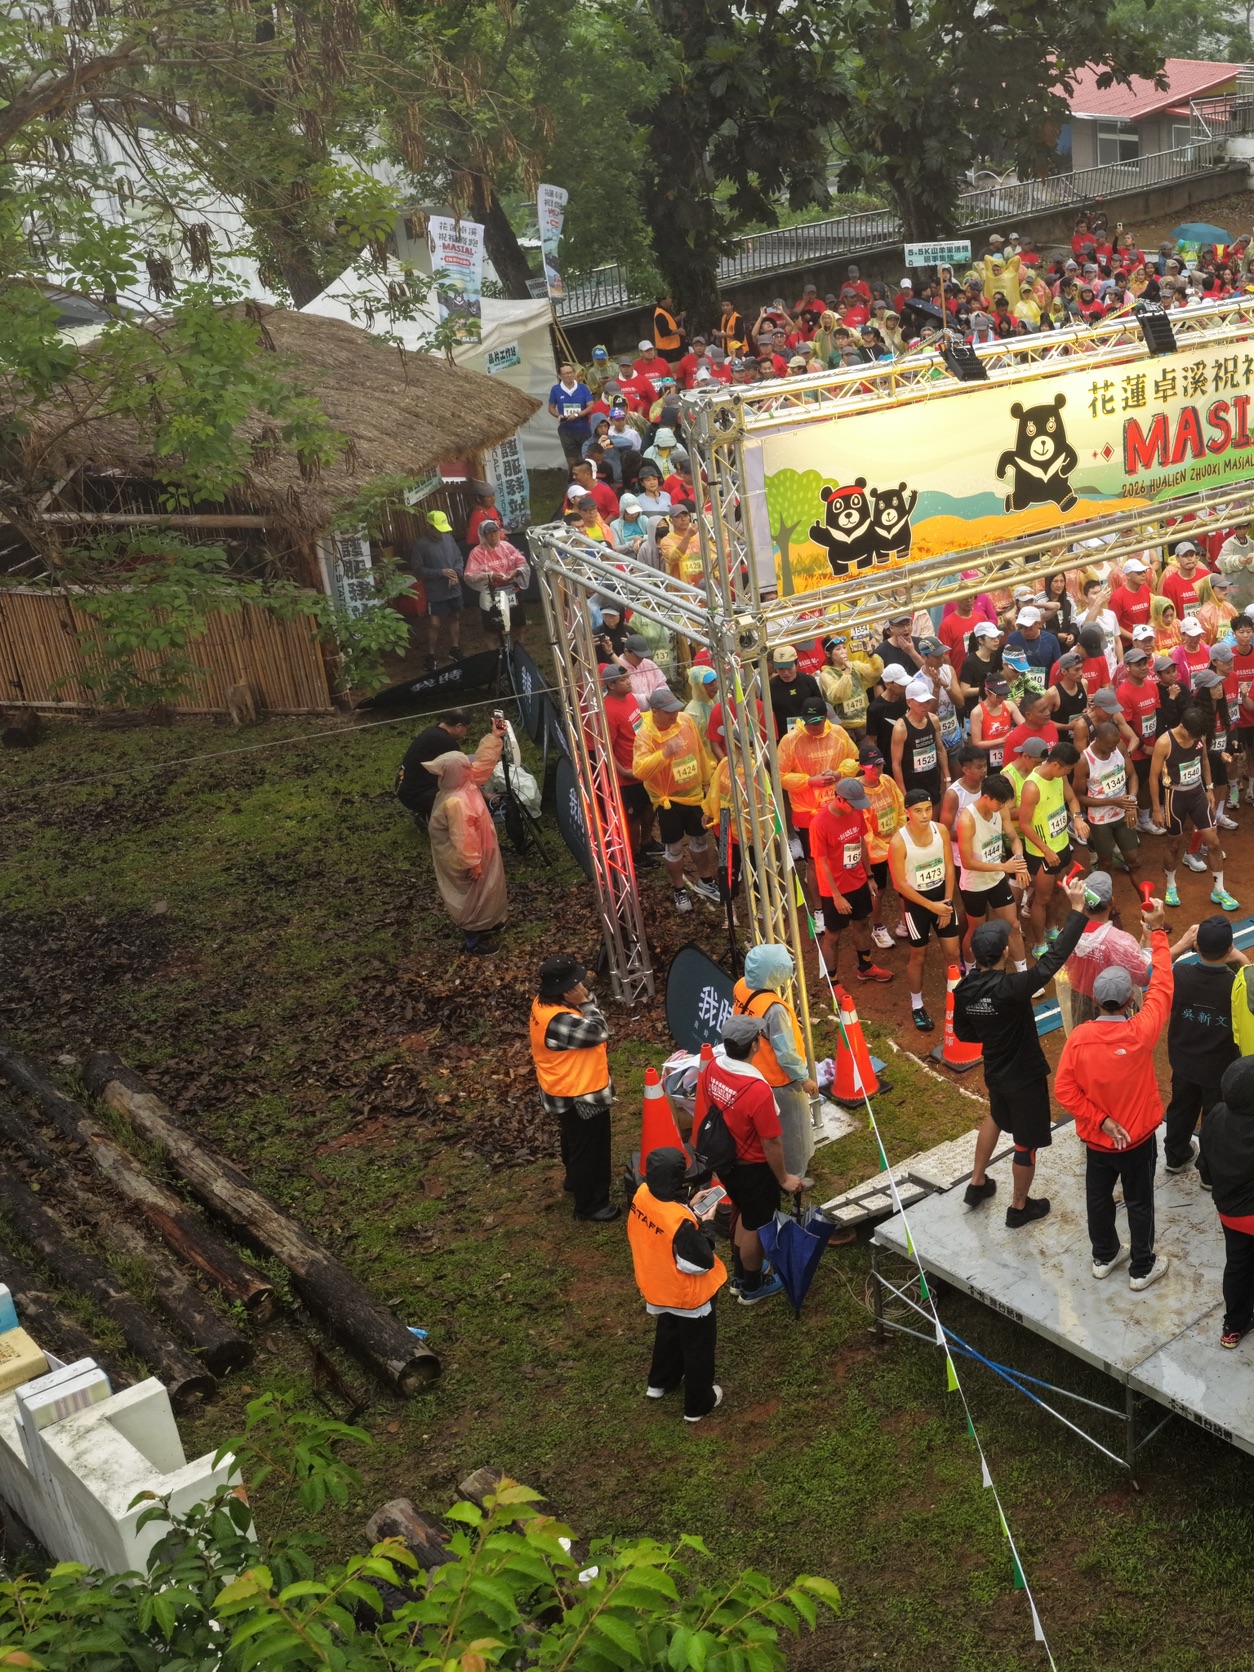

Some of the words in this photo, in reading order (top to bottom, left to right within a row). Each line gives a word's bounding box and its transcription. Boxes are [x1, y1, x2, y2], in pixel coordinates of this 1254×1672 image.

[442, 242, 474, 255] MASIAL
[1121, 483, 1146, 499] 2026
[1149, 473, 1187, 493] HUALIEN
[1190, 462, 1221, 483] ZHUOXI
[916, 753, 935, 767] 1525
[676, 764, 696, 777] 1424
[1183, 768, 1200, 780] 1540
[1105, 774, 1126, 790] 1344
[1050, 816, 1067, 829] 1418
[983, 845, 1001, 858] 1444
[919, 868, 943, 883] 1473
[1181, 1008, 1229, 1028] 吳新文
